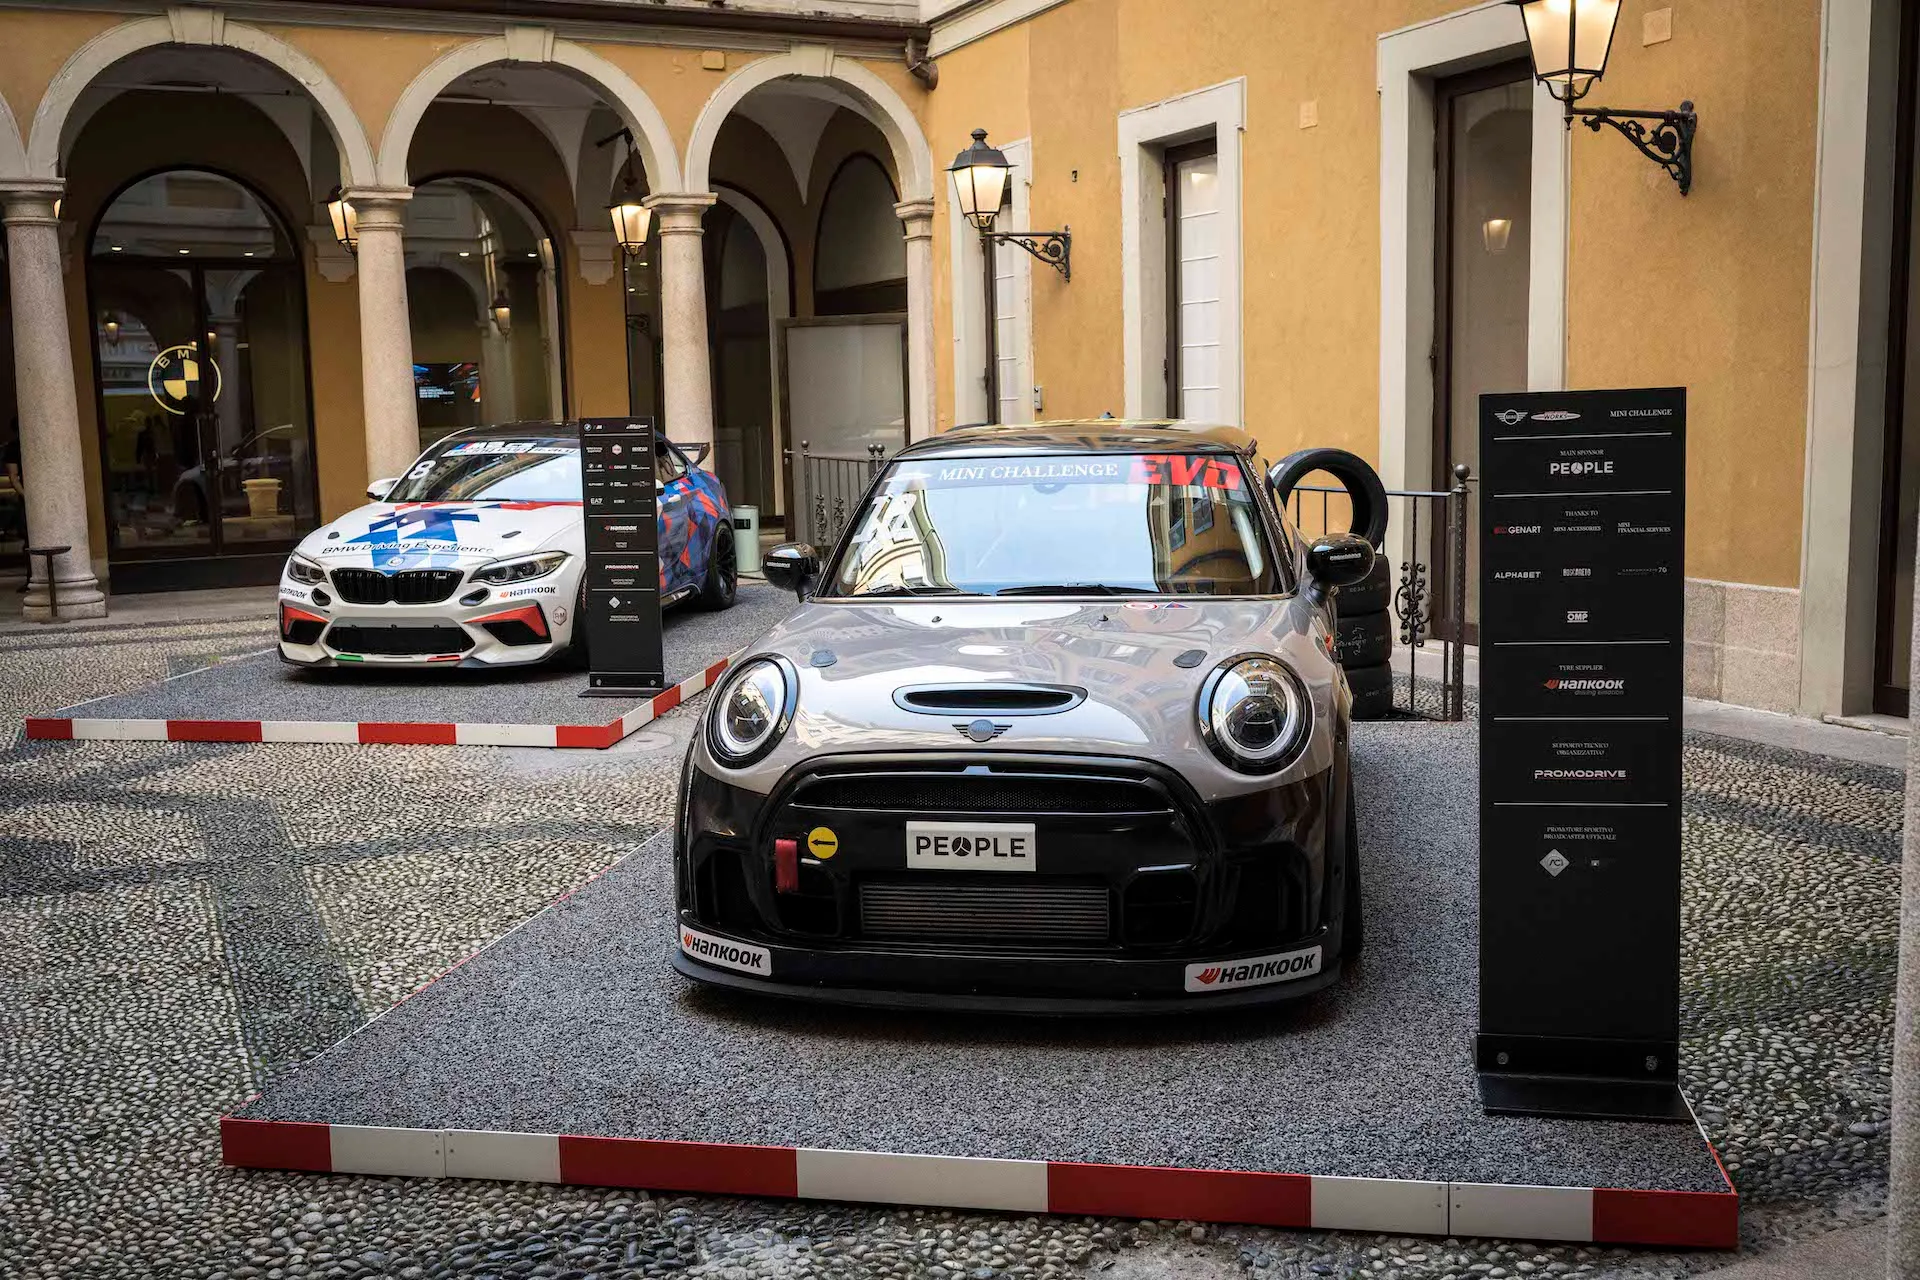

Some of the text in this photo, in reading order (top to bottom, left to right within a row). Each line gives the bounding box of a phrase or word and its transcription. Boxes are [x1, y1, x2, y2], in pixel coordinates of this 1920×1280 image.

[1628, 409, 1673, 417] CHALLENGE
[408, 460, 436, 480] 8
[938, 454, 1242, 490] MINI CHALLENGE EVO
[1549, 461, 1614, 475] PEOPLE
[1508, 525, 1542, 535] GENART
[322, 540, 494, 555] BMW Driving Experience
[1494, 571, 1542, 579] ALPHABET
[1567, 613, 1588, 621] OMP
[1574, 689, 1596, 697] driving
[1534, 769, 1627, 779] PROMODRIVE
[916, 836, 1026, 858] PEOPLE
